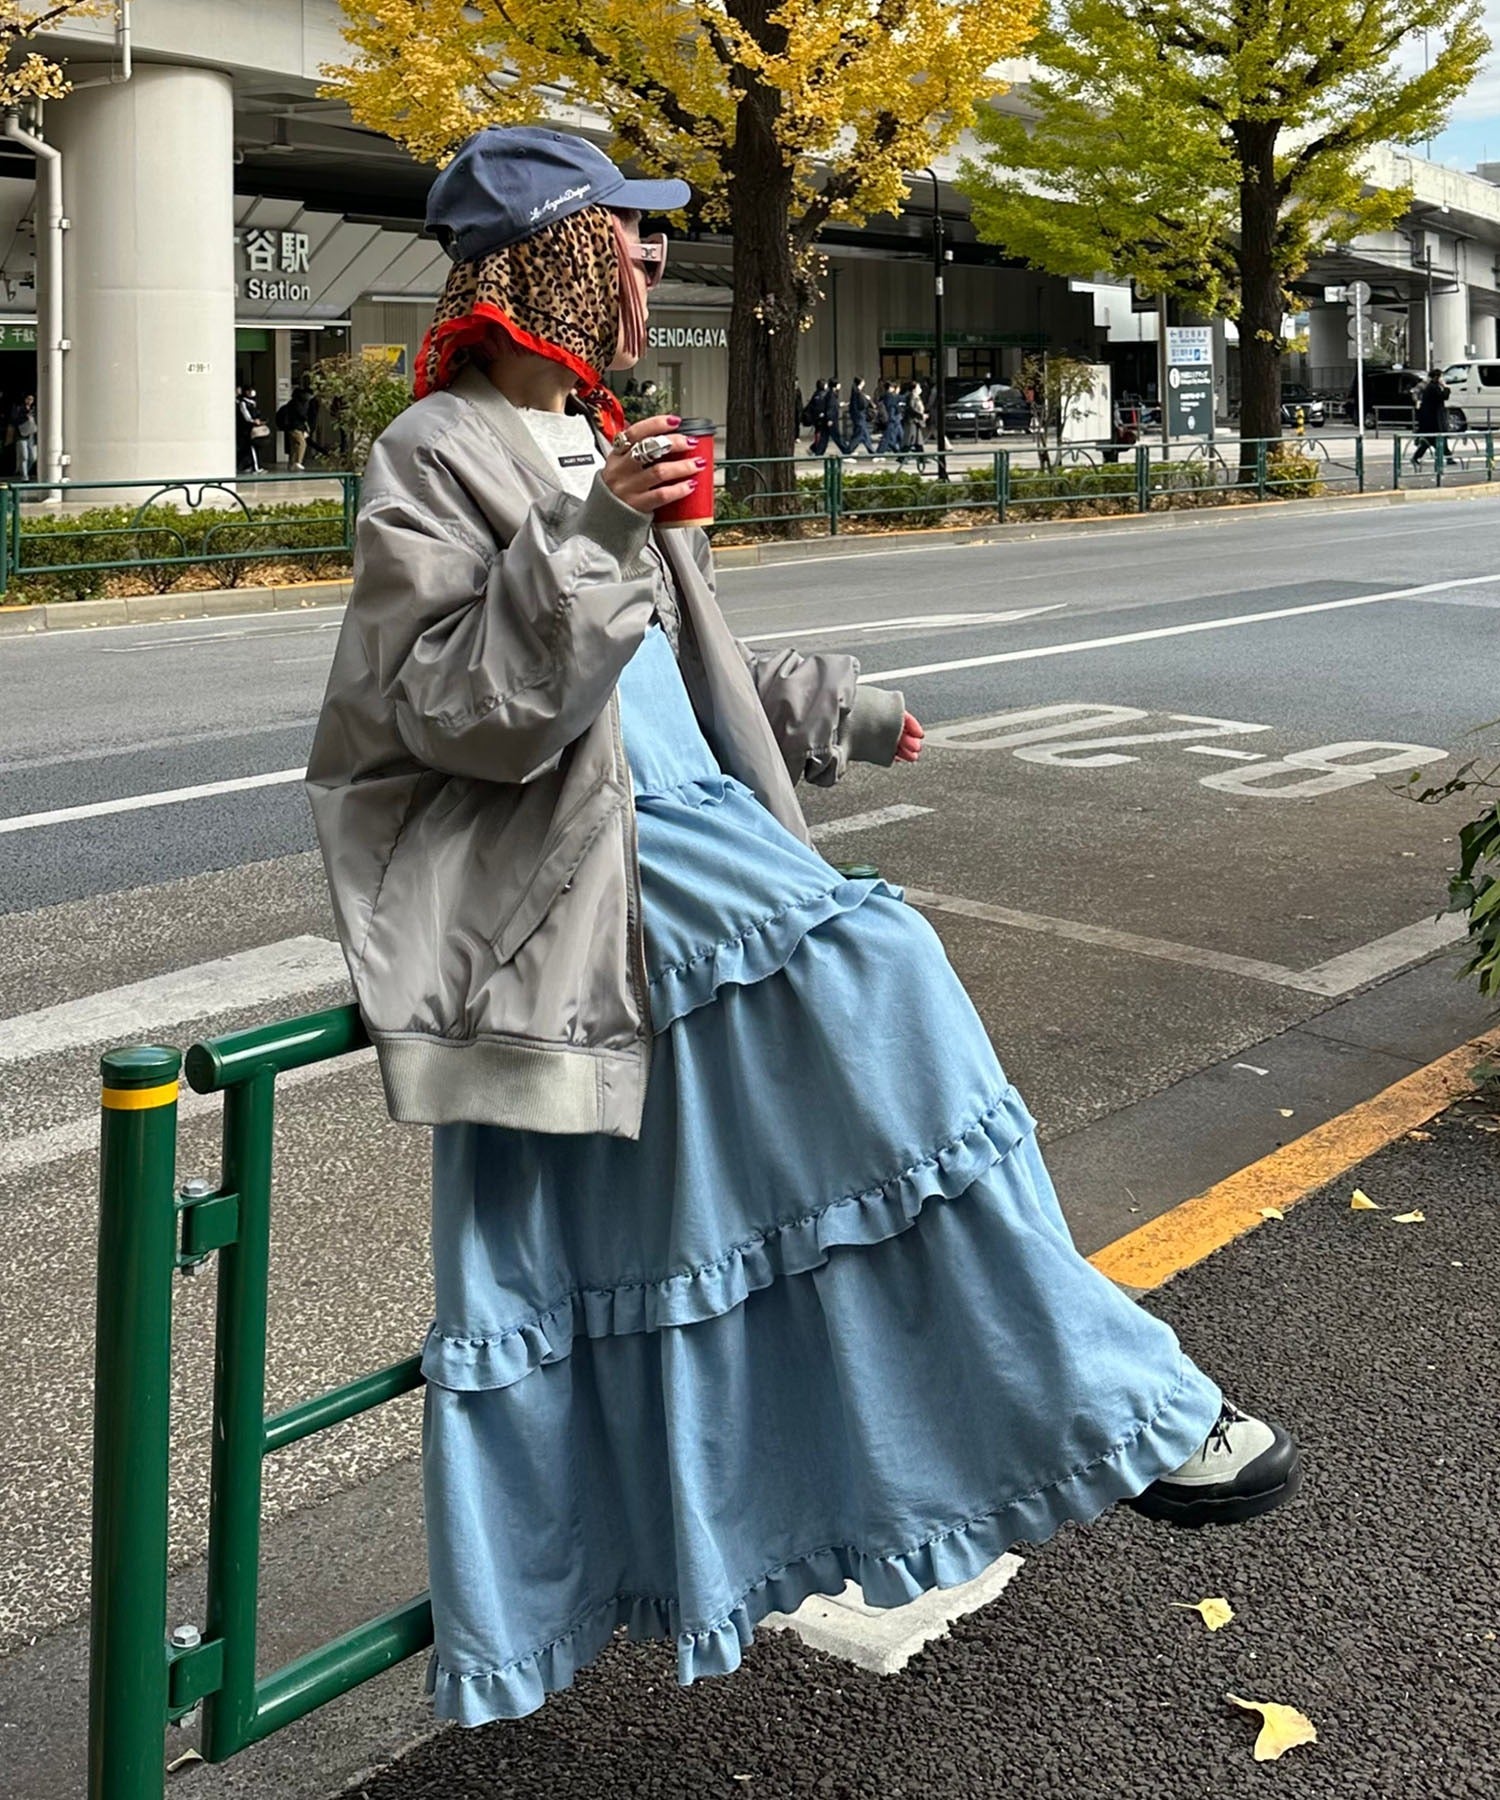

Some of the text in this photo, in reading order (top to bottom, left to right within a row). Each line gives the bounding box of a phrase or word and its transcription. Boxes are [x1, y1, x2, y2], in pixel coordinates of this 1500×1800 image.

[234, 229, 310, 273] 谷駅
[248, 278, 311, 300] Station
[648, 326, 728, 348] SENDAGAYA
